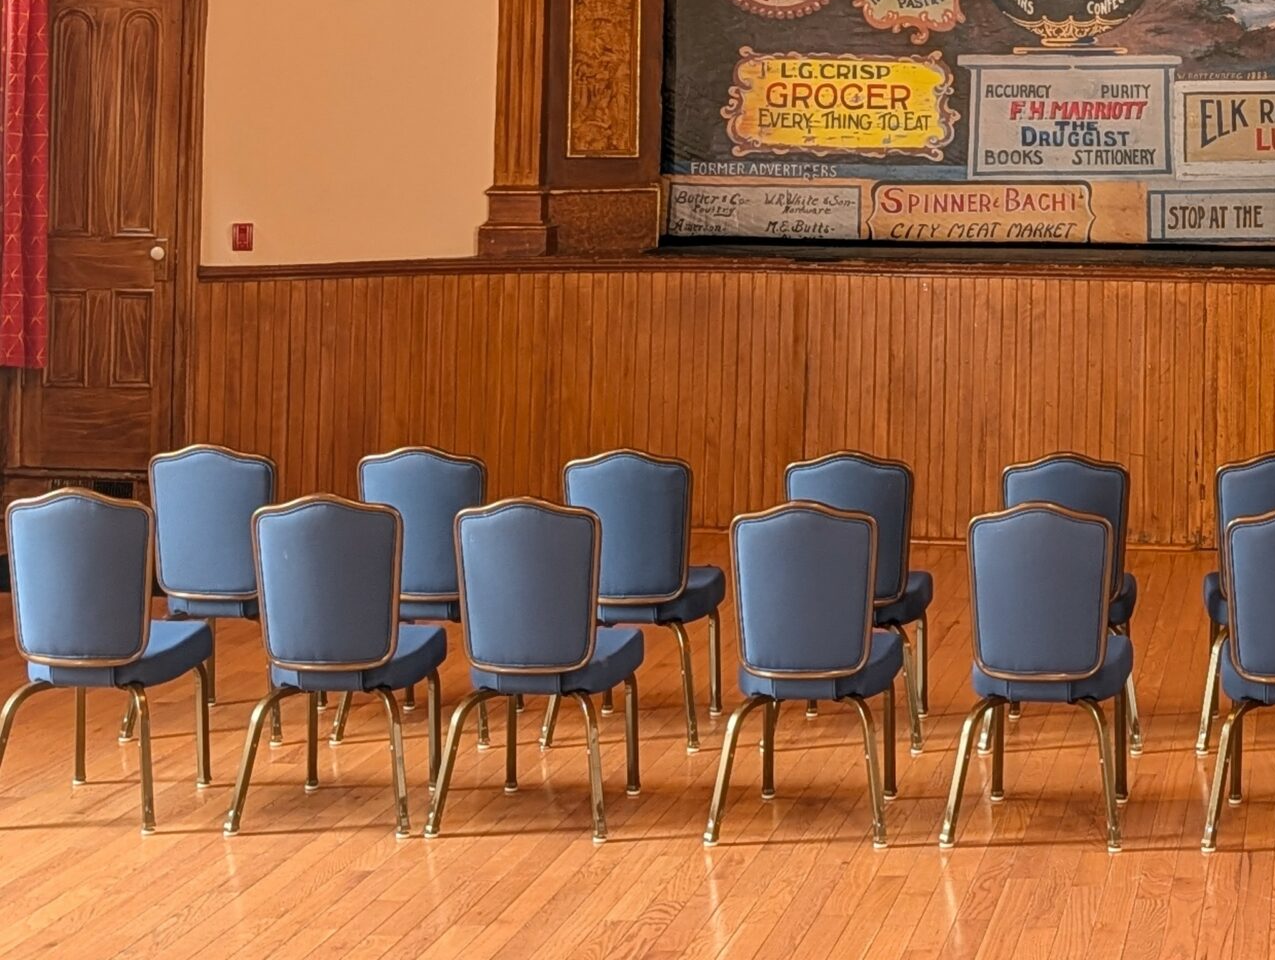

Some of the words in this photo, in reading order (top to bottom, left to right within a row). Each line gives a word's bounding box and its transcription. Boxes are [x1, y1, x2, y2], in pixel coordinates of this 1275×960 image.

[819, 63, 891, 80] CRISP
[765, 82, 911, 111] GROCER
[985, 84, 1052, 99] ACCURACY
[1101, 84, 1152, 99] PURITY
[1049, 101, 1148, 120] MARRIOTT
[879, 112, 900, 132] TO
[903, 111, 932, 132] EAT
[1054, 121, 1099, 132] THE
[1200, 97, 1249, 148] ELK
[1021, 126, 1131, 147] DRUGGIST
[984, 149, 1044, 166] BOOKS
[1071, 149, 1157, 166] STATIONERY
[690, 162, 746, 176] FORMER
[880, 187, 991, 215] SPINNER
[1167, 205, 1206, 230] STOP
[1208, 205, 1229, 229] AT
[1232, 205, 1264, 229] THE
[890, 222, 941, 240] CITY
[947, 222, 1001, 239] MEAT
[1006, 222, 1078, 239] MARKET
